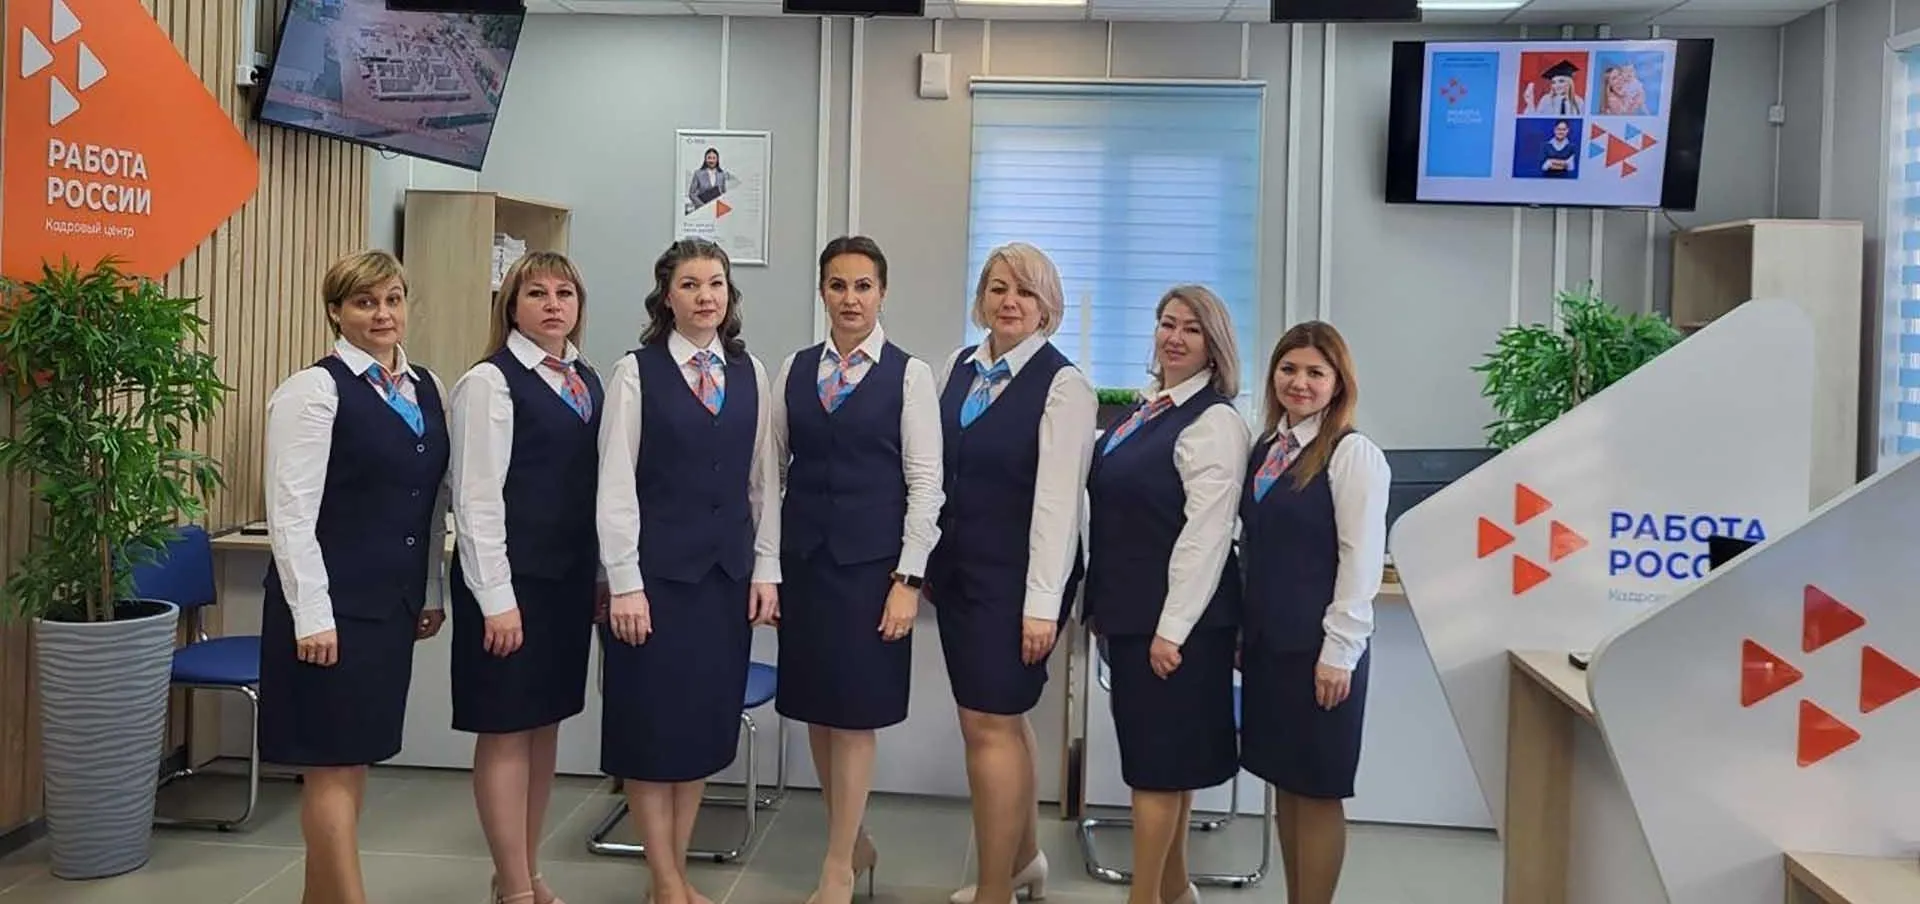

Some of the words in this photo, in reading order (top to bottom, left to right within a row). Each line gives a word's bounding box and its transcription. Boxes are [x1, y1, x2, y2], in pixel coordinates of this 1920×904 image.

[48, 138, 148, 180] РАБОТА
[47, 176, 151, 216] РОССИИ
[45, 217, 102, 235] Кадровый
[104, 223, 135, 239] центр
[1609, 511, 1766, 543] РАБОТА
